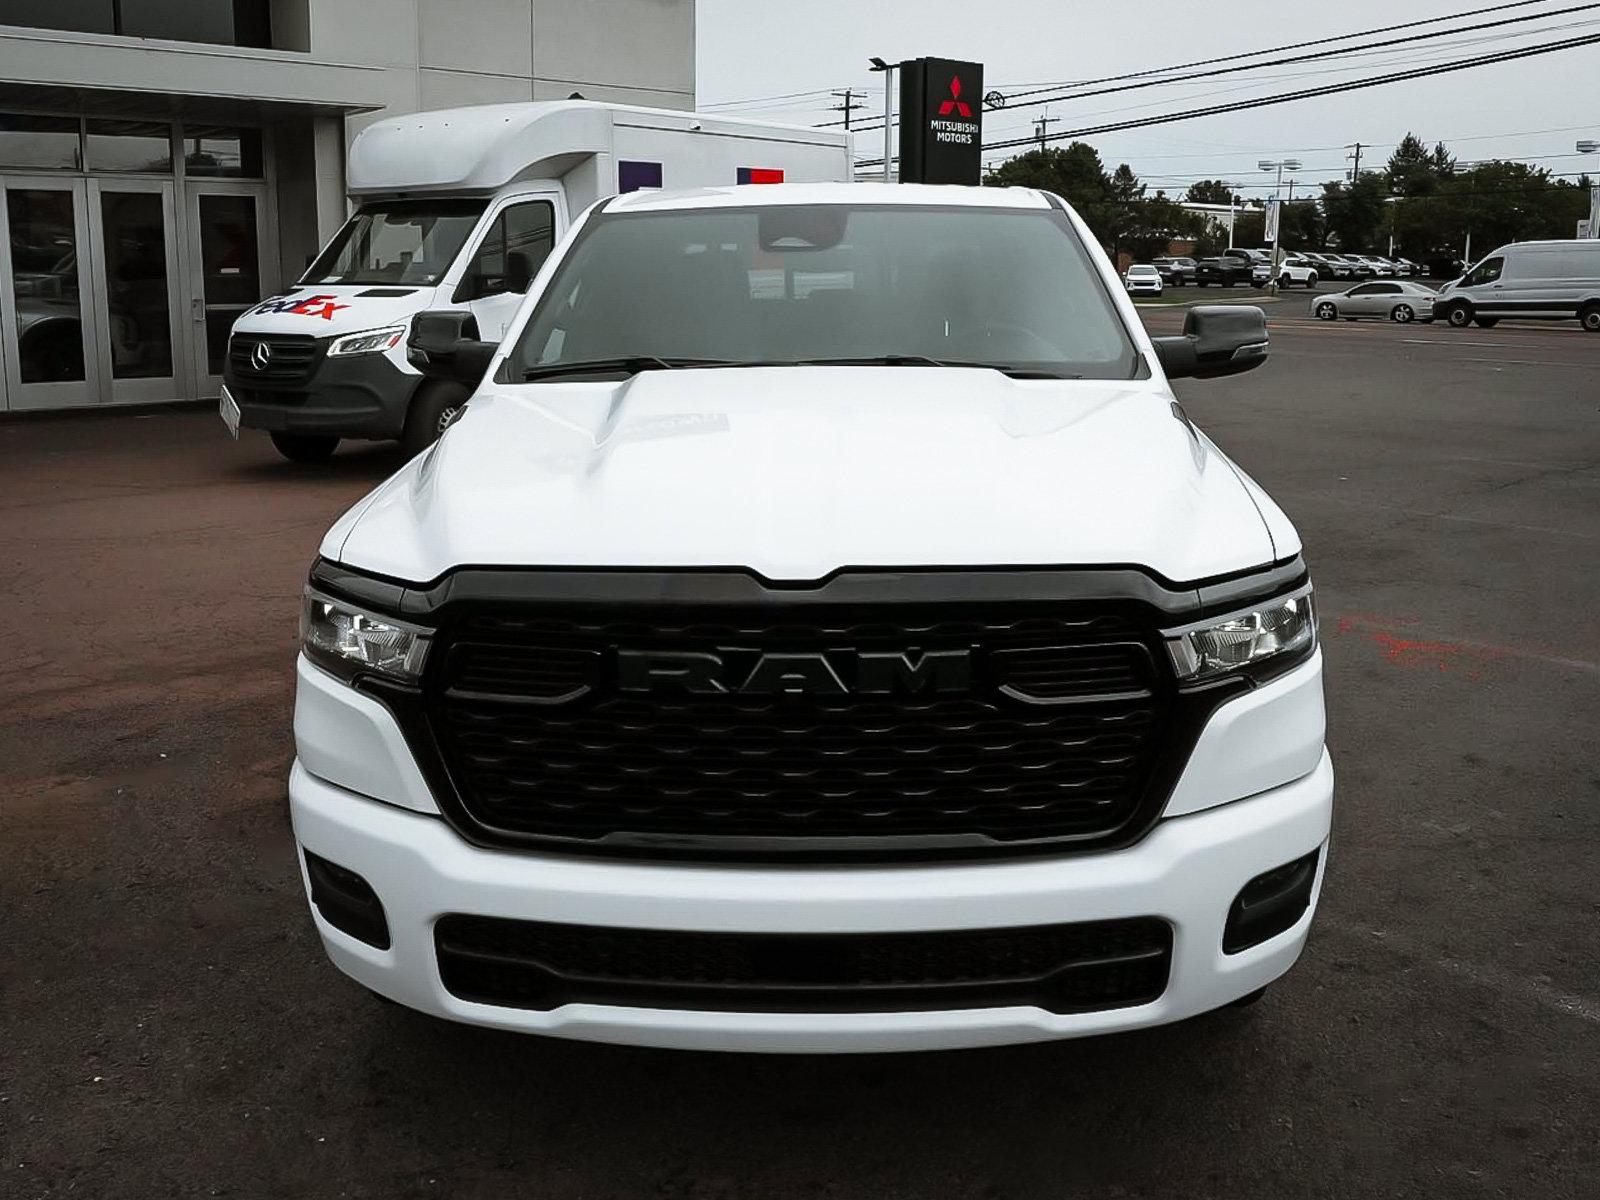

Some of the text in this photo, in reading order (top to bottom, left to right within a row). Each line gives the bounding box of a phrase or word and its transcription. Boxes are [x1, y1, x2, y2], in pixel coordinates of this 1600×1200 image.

[931, 120, 979, 133] MITSUBISHI
[937, 132, 972, 144] MOTORS
[617, 650, 972, 695] RAM
